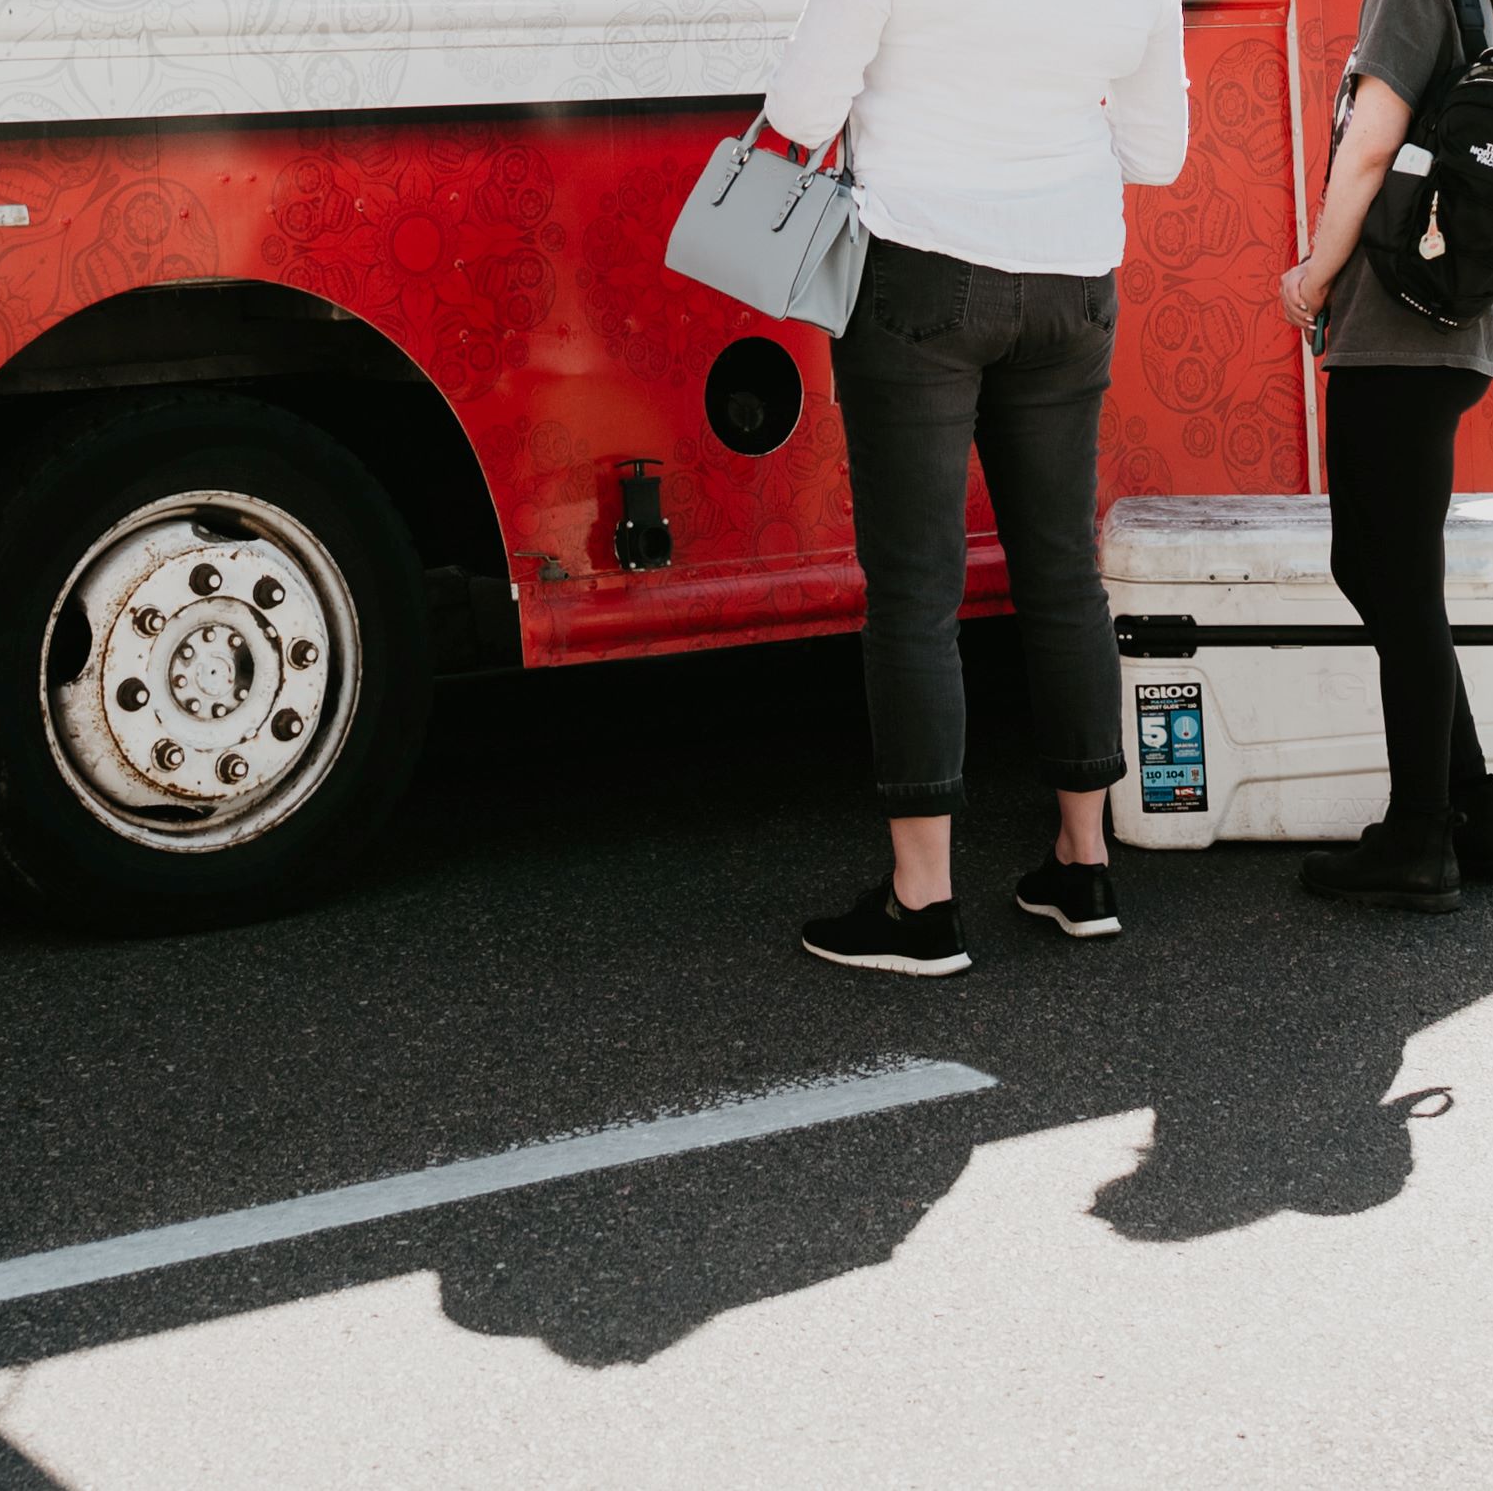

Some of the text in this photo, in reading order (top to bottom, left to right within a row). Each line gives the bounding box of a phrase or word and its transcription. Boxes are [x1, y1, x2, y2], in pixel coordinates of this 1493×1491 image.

[1138, 686, 1198, 700] IGLOO
[1141, 716, 1168, 748] 5
[1145, 771, 1162, 779] 110
[1166, 770, 1185, 779] 104
